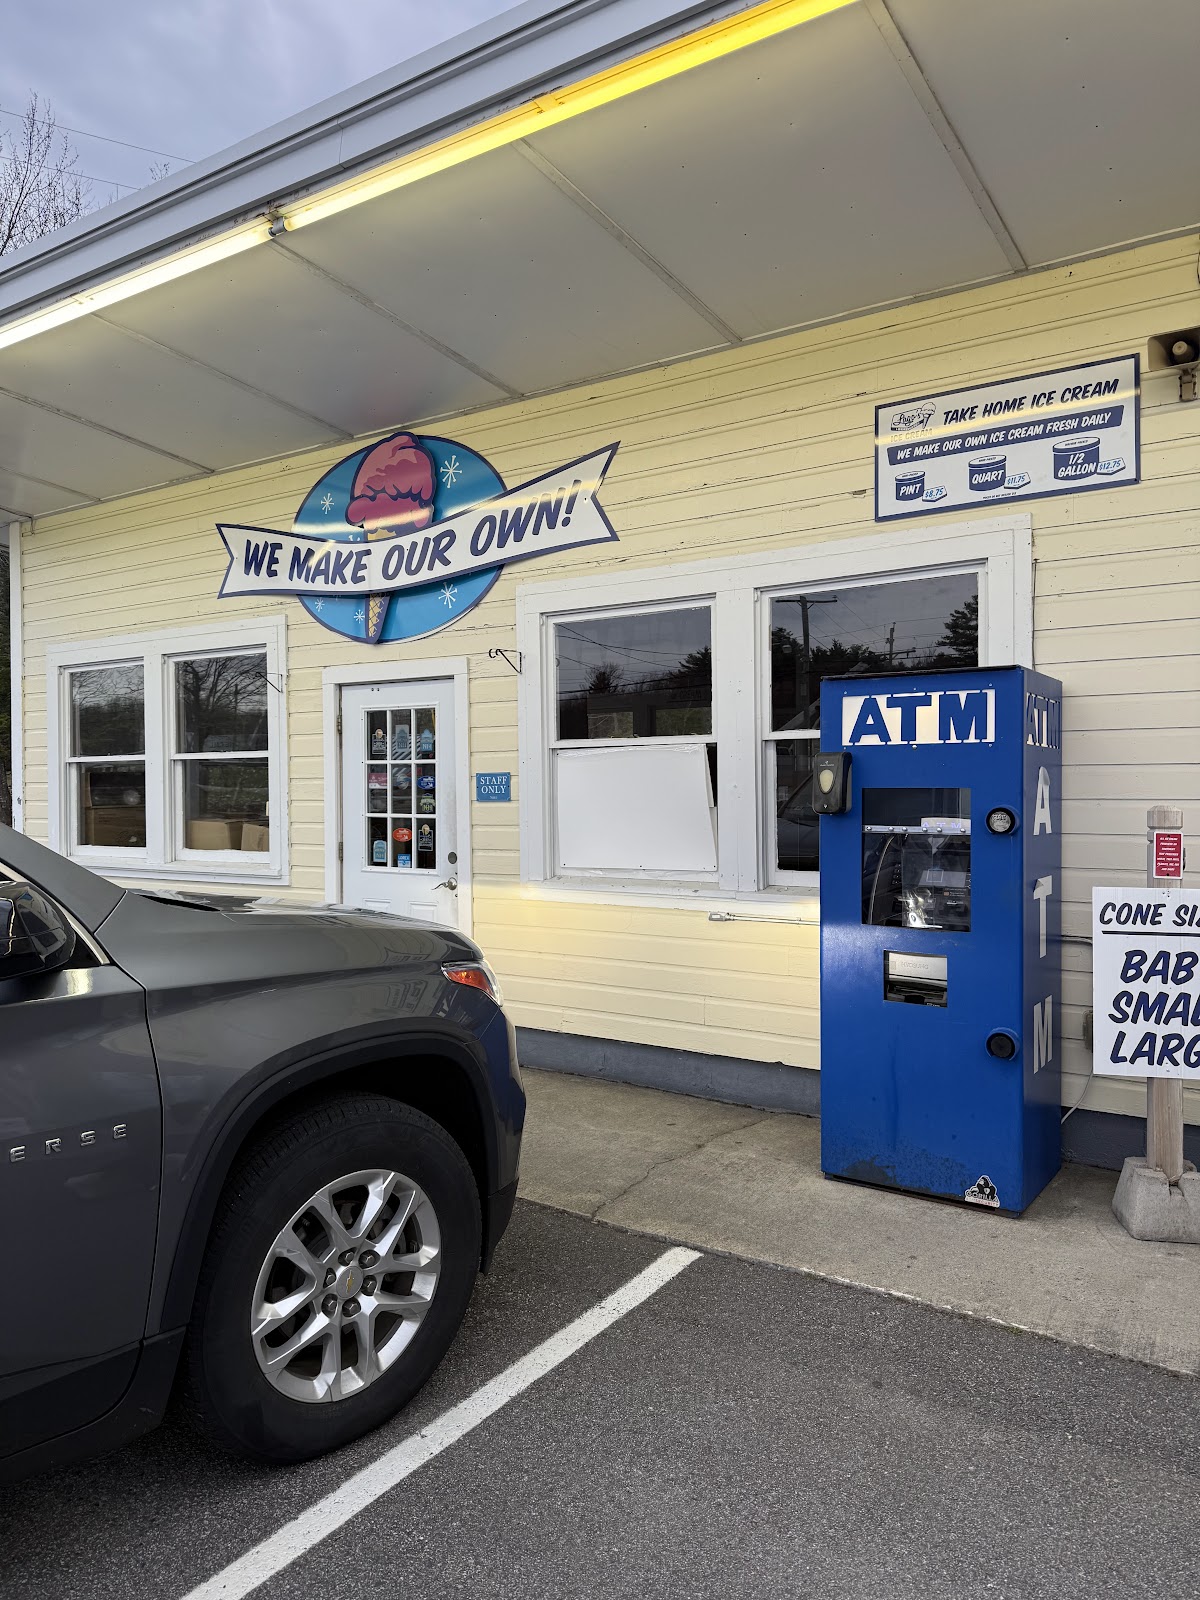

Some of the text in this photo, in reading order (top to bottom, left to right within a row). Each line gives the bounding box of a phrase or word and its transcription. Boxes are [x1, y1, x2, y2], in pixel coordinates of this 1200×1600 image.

[943, 378, 1119, 426] TAKE HOME ICE CREAM
[890, 433, 903, 443] ICE
[905, 428, 933, 440] CREAM
[897, 412, 1112, 460] WE MAKE OUR OWN ICE CREAM FRESH DAILY
[1068, 453, 1085, 466] 1/2
[1099, 459, 1122, 472] $12.75
[971, 469, 1005, 485] QUART
[1057, 462, 1097, 478] GALLON
[1006, 474, 1026, 485] $11.75
[899, 483, 922, 497] PINT
[925, 487, 944, 498] $8.75
[243, 479, 583, 586] WE MAKE OUR OWN!
[846, 690, 990, 744] ATM
[1027, 692, 1060, 749] ATM
[480, 776, 508, 785] STAFF
[481, 785, 507, 794] ONLY
[1099, 902, 1167, 925] CONE
[1120, 949, 1199, 985] BAB
[1110, 1031, 1200, 1068] LARG
[9, 1123, 127, 1163] ERSE
